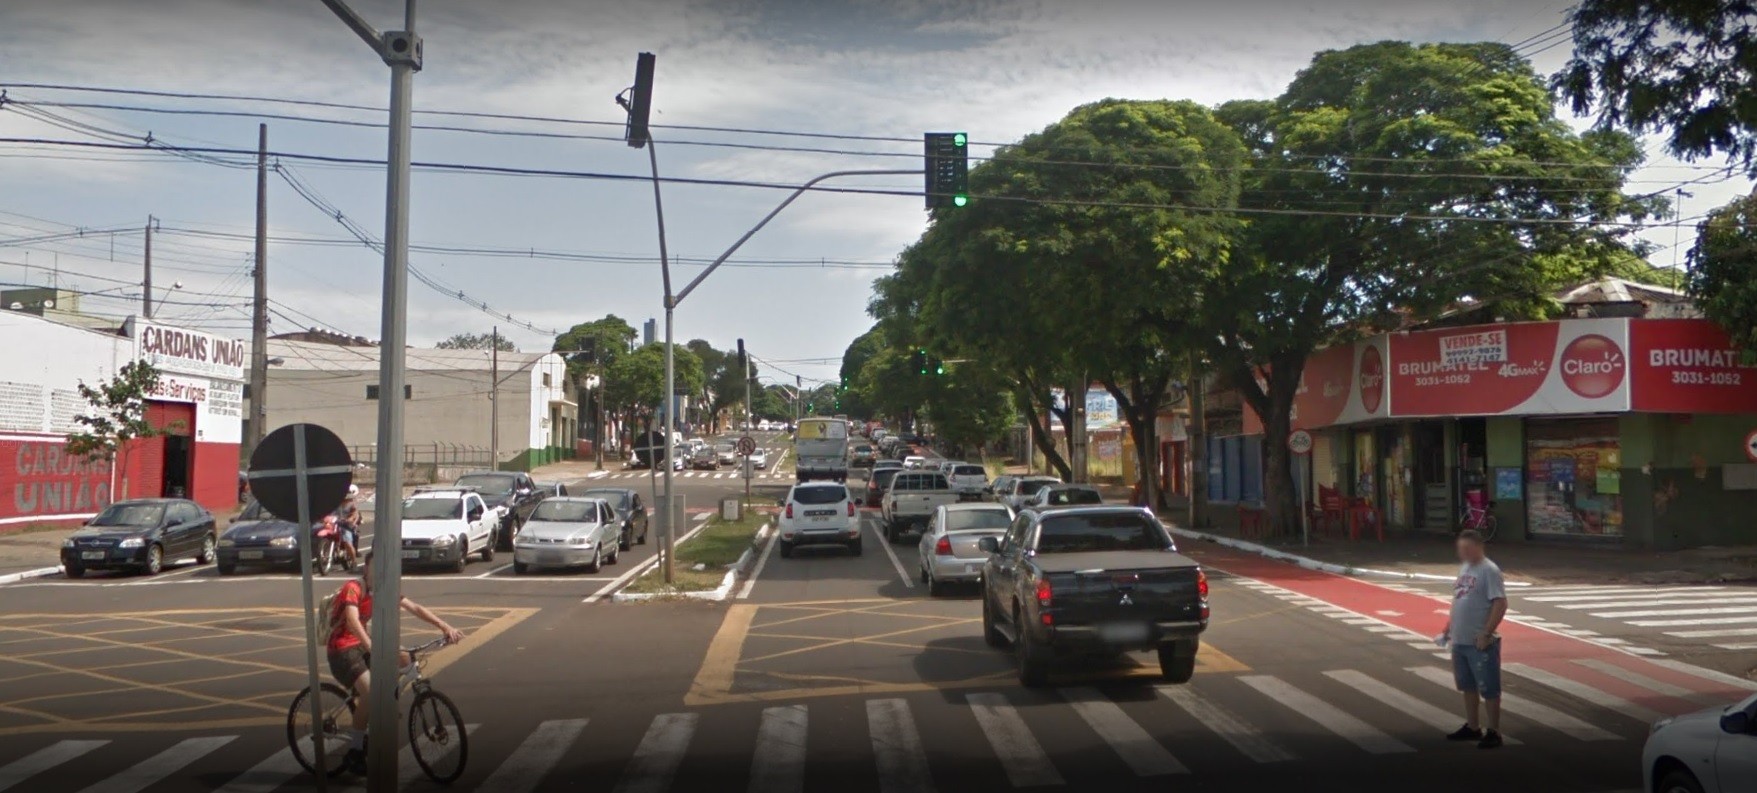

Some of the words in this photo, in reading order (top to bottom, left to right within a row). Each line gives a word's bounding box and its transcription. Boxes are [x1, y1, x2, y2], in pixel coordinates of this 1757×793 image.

[144, 326, 208, 362] CARDANS
[1444, 334, 1502, 349] VENDE-SE
[1563, 358, 1613, 375] Claro
[1650, 349, 1757, 368] BRUMAT
[1415, 374, 1471, 386] 3031-1052
[1671, 371, 1741, 386] 3031-1052
